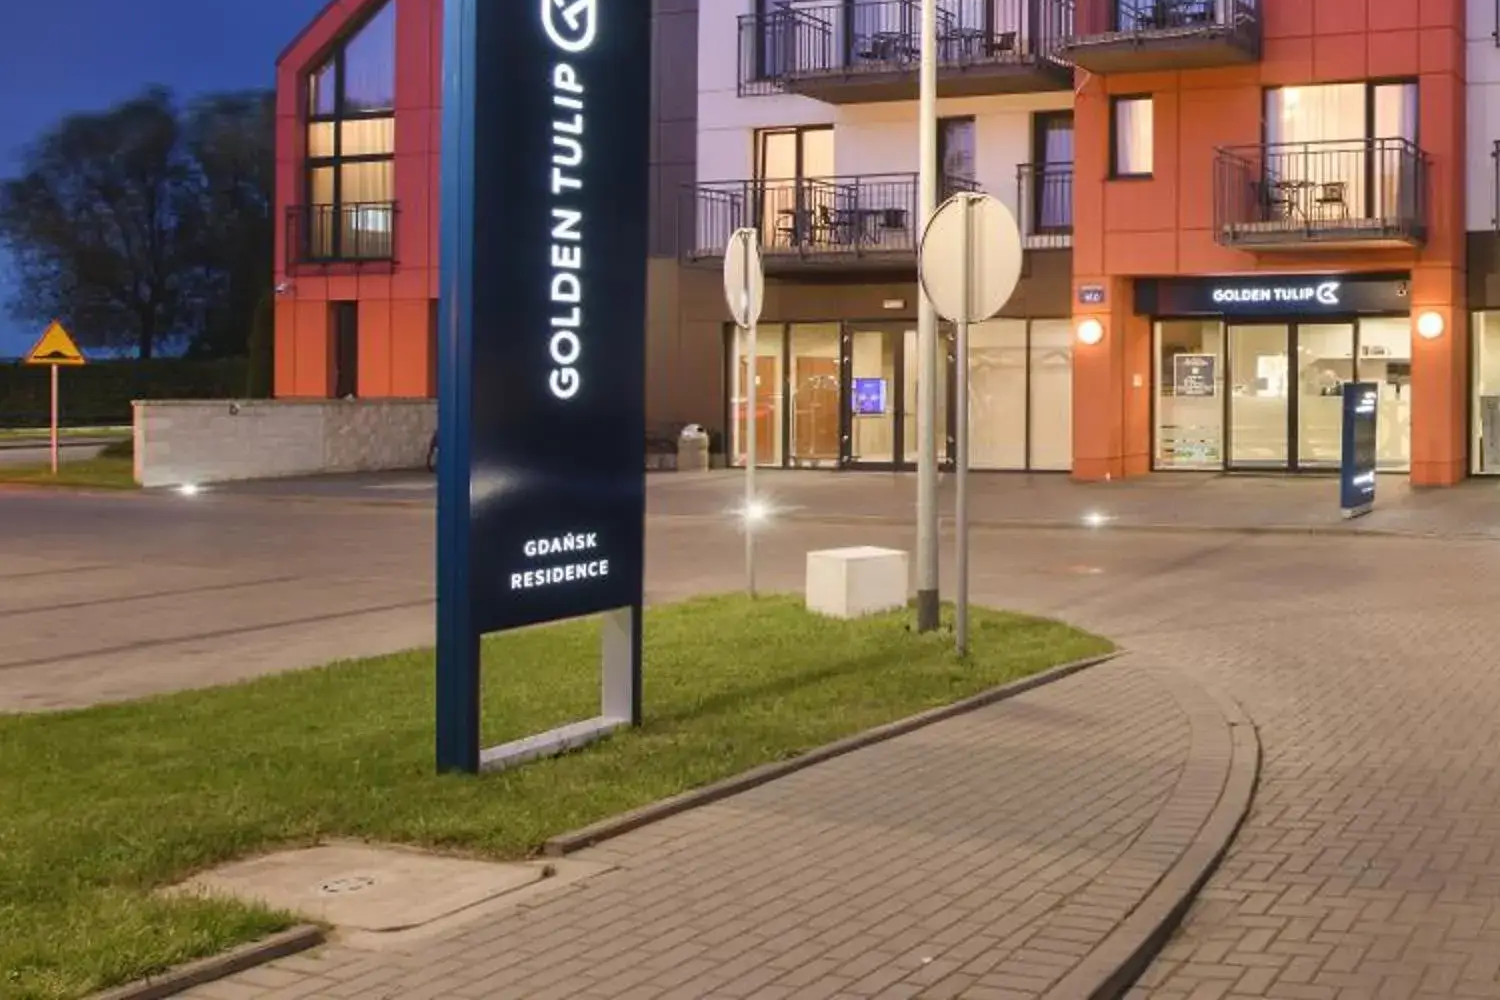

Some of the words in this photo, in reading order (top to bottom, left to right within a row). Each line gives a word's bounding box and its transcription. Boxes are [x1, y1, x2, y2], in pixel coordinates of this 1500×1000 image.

[551, 62, 585, 195] TULIP
[548, 208, 583, 400] GOLDEN
[1212, 288, 1271, 302] GOLDEN
[1274, 287, 1315, 301] TULIP
[524, 532, 597, 557] GDAŃSK
[510, 559, 609, 589] RESIDENCE
